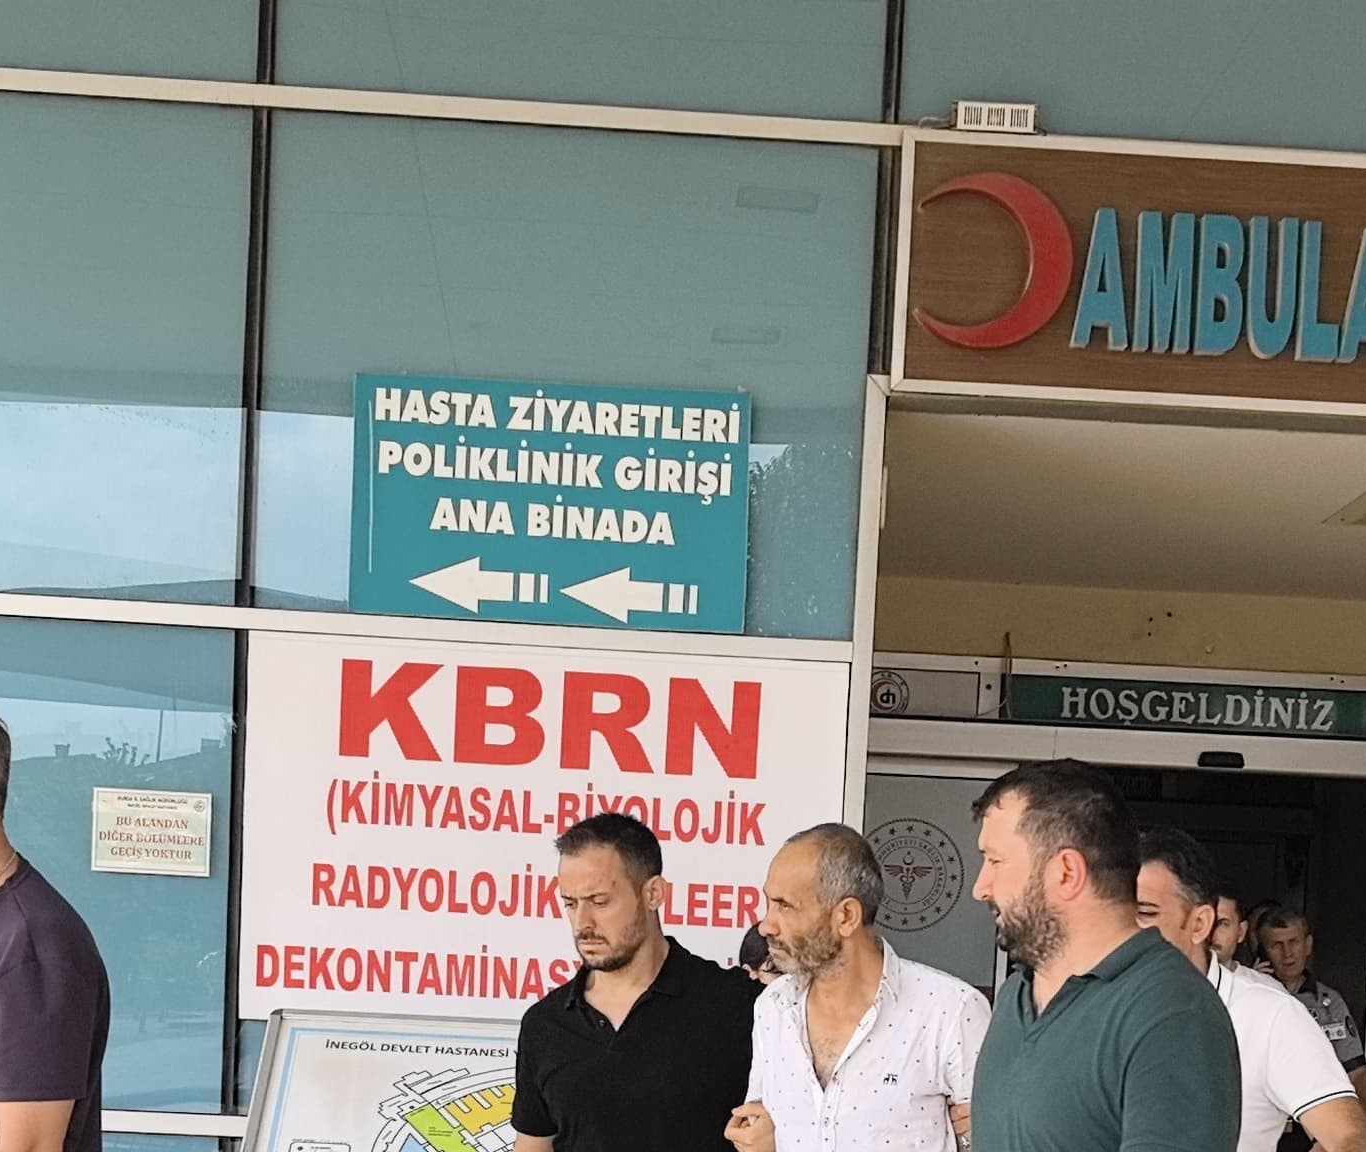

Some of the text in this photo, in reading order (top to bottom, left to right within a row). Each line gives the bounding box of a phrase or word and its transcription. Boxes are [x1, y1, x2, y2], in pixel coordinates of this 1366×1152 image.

[374, 387, 741, 444] HASTA ZİYARETLERİ
[378, 435, 733, 505] POLİKLİNİK GİRİŞİ
[429, 494, 676, 546] ANA BİNADA
[338, 658, 762, 779] KBRN
[1060, 689, 1335, 731] HOŞGELDİNİZ
[116, 816, 189, 829] BU ALANDAN
[145, 848, 192, 860] YOKTUR
[311, 862, 761, 929] RADYOLOJİK LEER
[255, 943, 582, 1000] DEKONTAMİNAS
[325, 1039, 376, 1051] İNEGÖL
[380, 1043, 431, 1054] DEVLET
[435, 1045, 509, 1058] HASTANESİ
